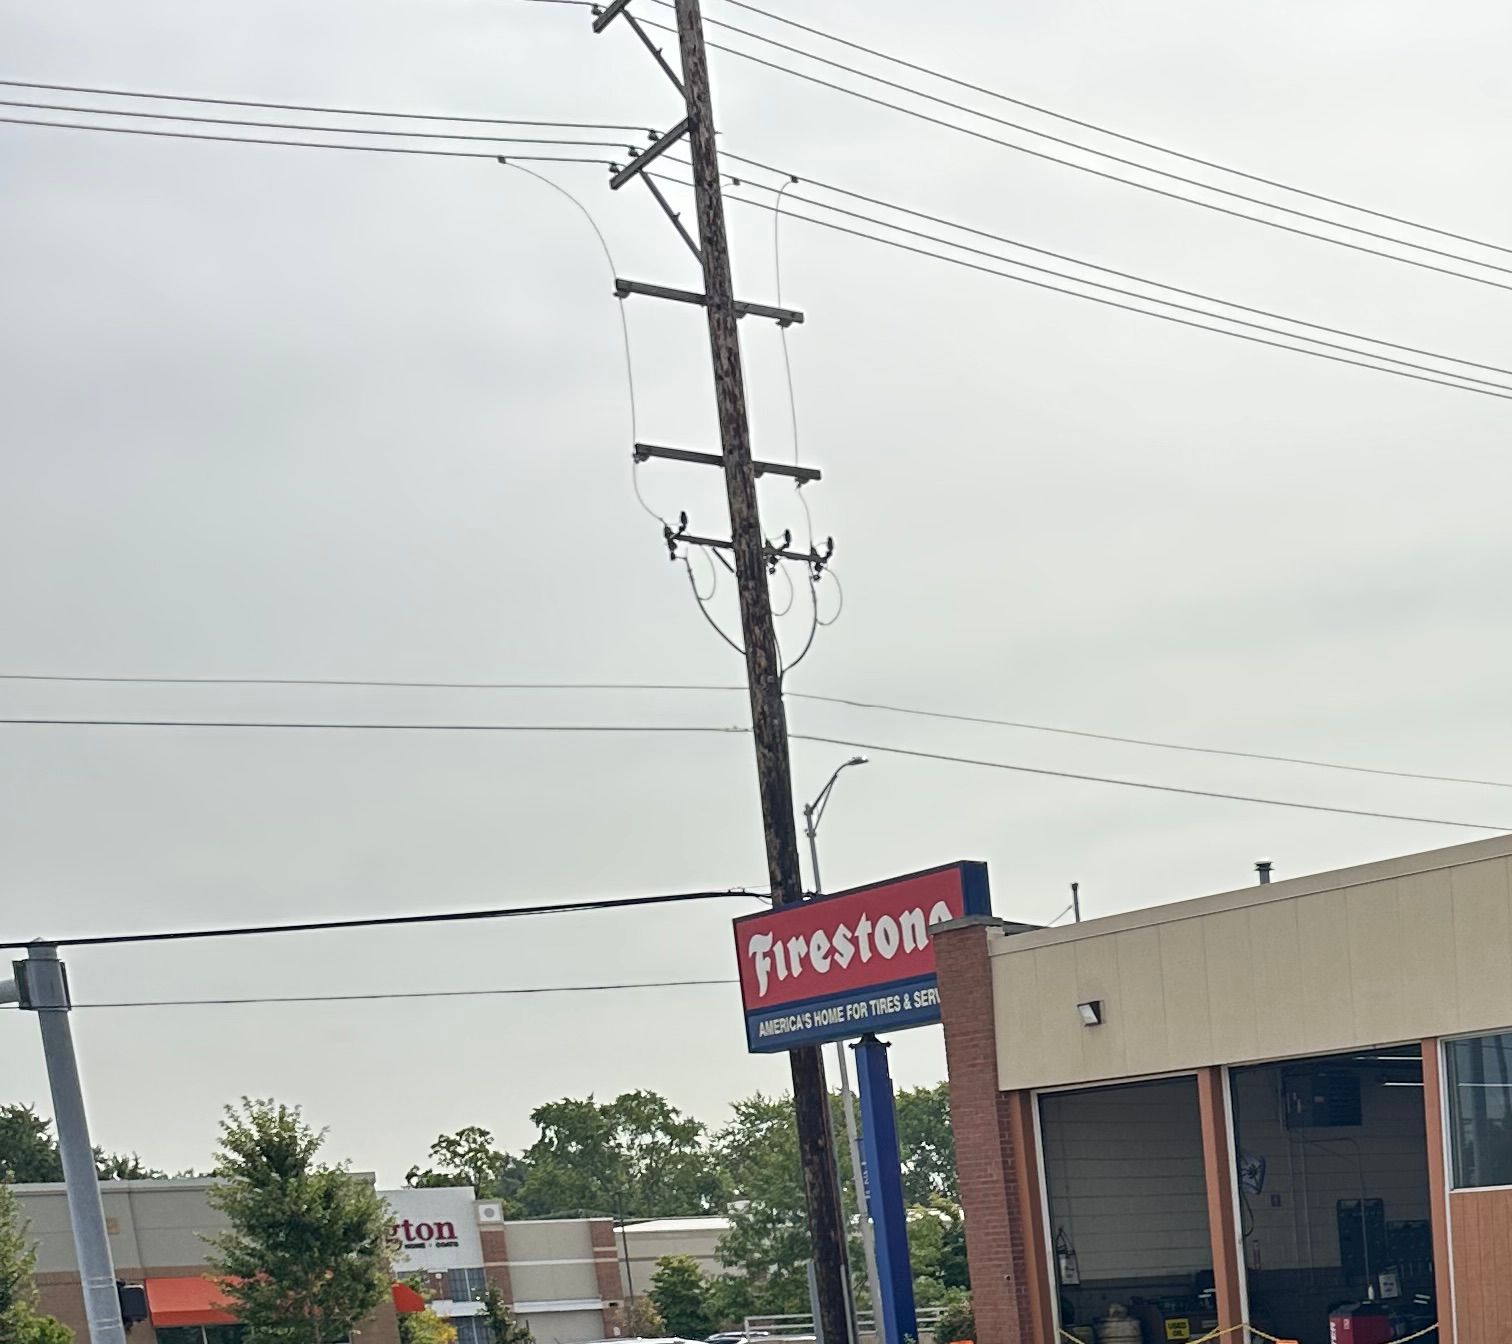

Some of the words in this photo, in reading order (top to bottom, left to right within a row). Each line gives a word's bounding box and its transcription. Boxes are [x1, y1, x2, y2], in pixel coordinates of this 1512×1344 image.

[758, 1012, 812, 1038] AMERICA'S
[814, 1005, 845, 1027] HOME
[846, 1001, 868, 1021] FOR
[869, 995, 901, 1016] TIRES
[903, 993, 912, 1010] &
